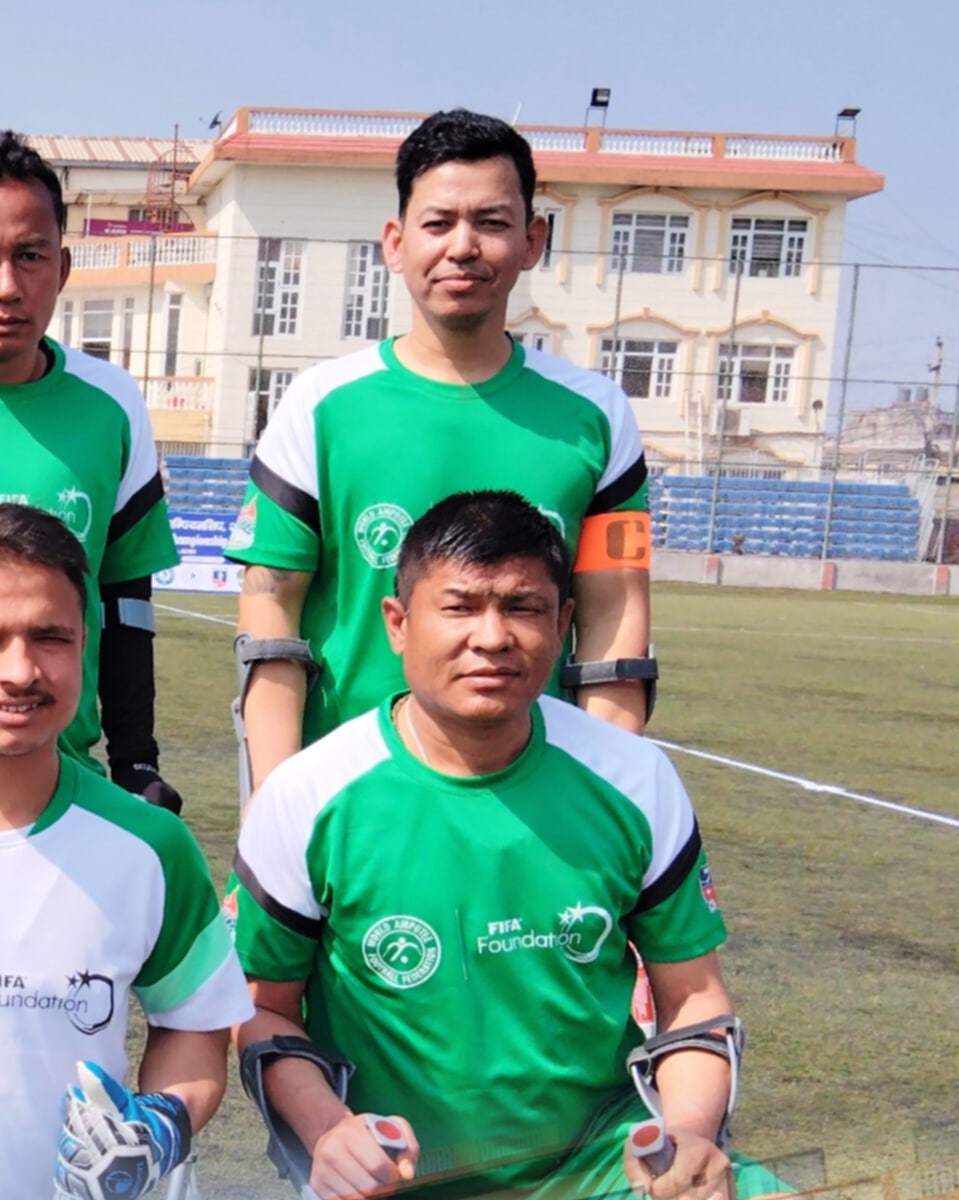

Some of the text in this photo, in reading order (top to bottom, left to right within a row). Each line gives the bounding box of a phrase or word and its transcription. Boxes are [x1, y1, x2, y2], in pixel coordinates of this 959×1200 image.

[606, 519, 646, 561] C
[366, 918, 434, 948] WORLD AMPUTEE
[487, 917, 522, 936] FIFA
[477, 929, 582, 955] Foundation
